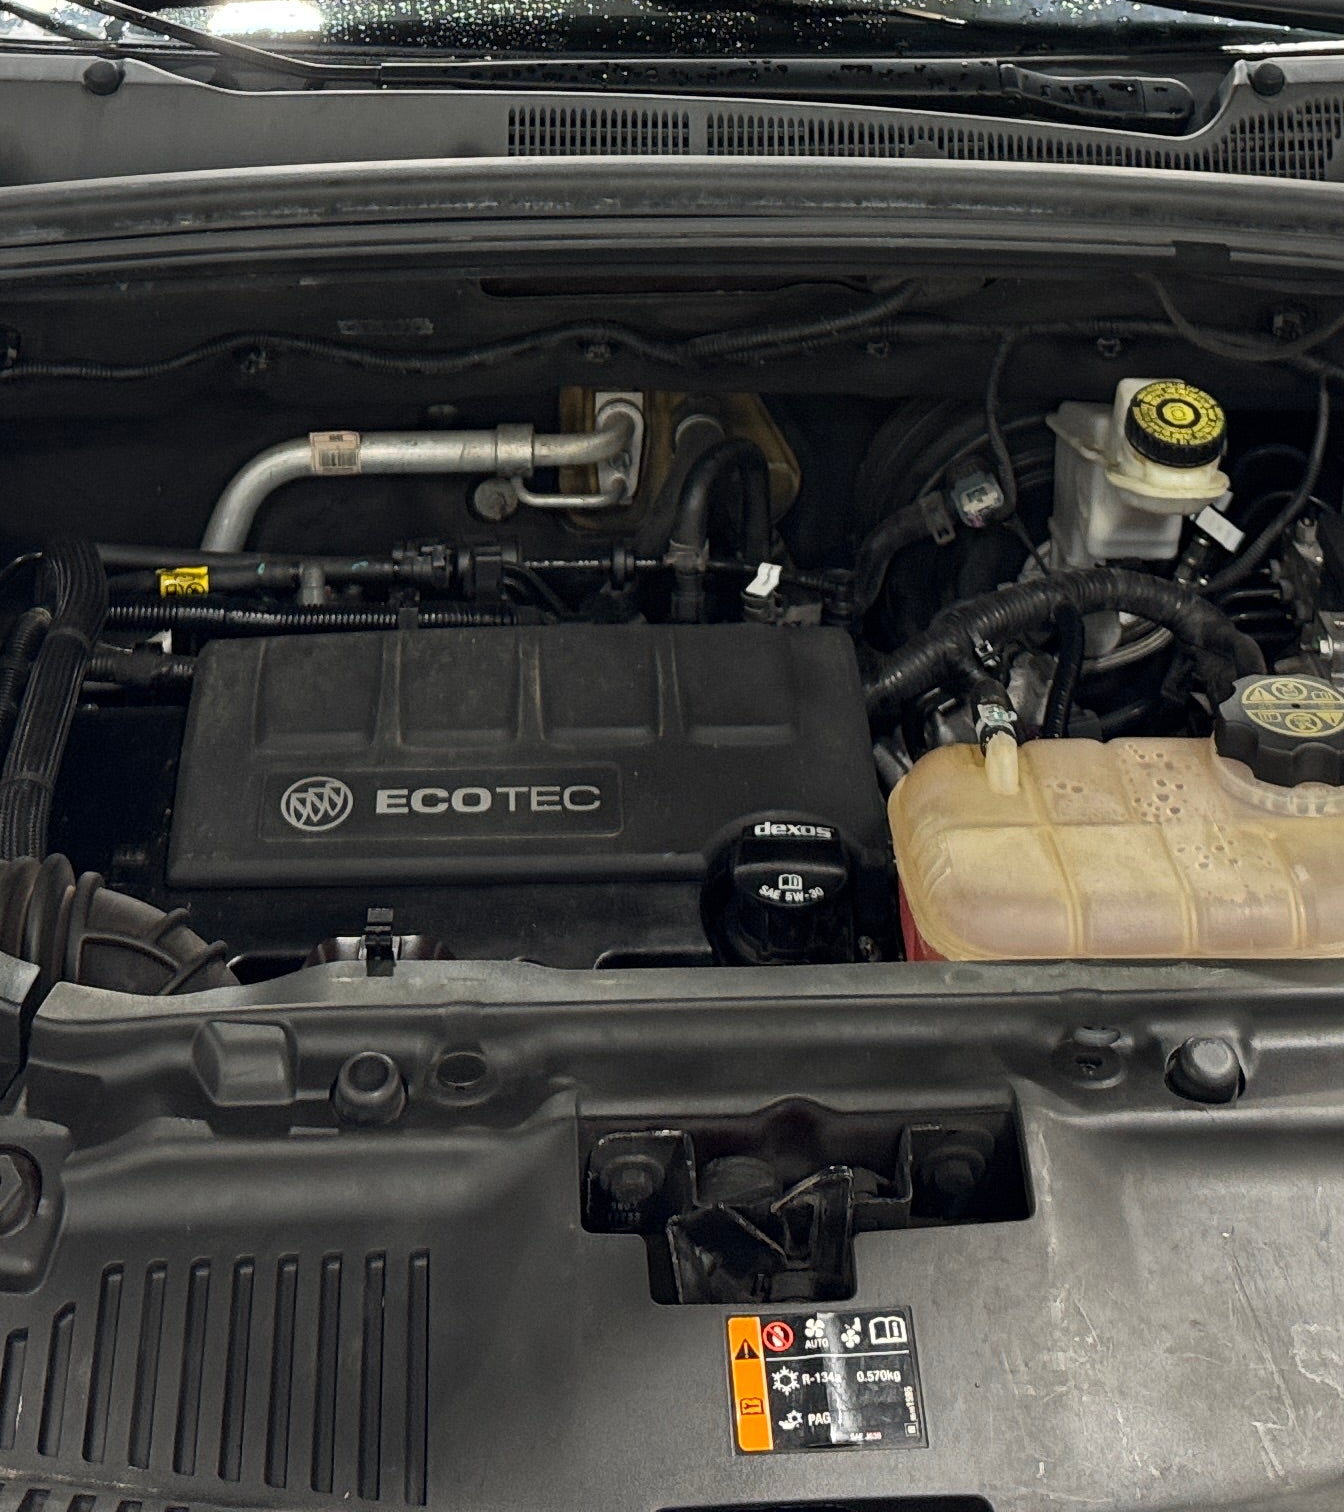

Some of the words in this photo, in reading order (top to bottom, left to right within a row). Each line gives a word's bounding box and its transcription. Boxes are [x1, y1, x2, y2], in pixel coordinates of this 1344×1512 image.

[375, 785, 601, 814] ECOTEC
[754, 821, 832, 839] dexos
[758, 884, 781, 900] SAE
[784, 886, 825, 902] 5W-30
[804, 1337, 829, 1349] AUTO
[801, 1372, 842, 1386] R-134a
[856, 1369, 901, 1383] 0.570kg
[808, 1412, 831, 1426] PAG
